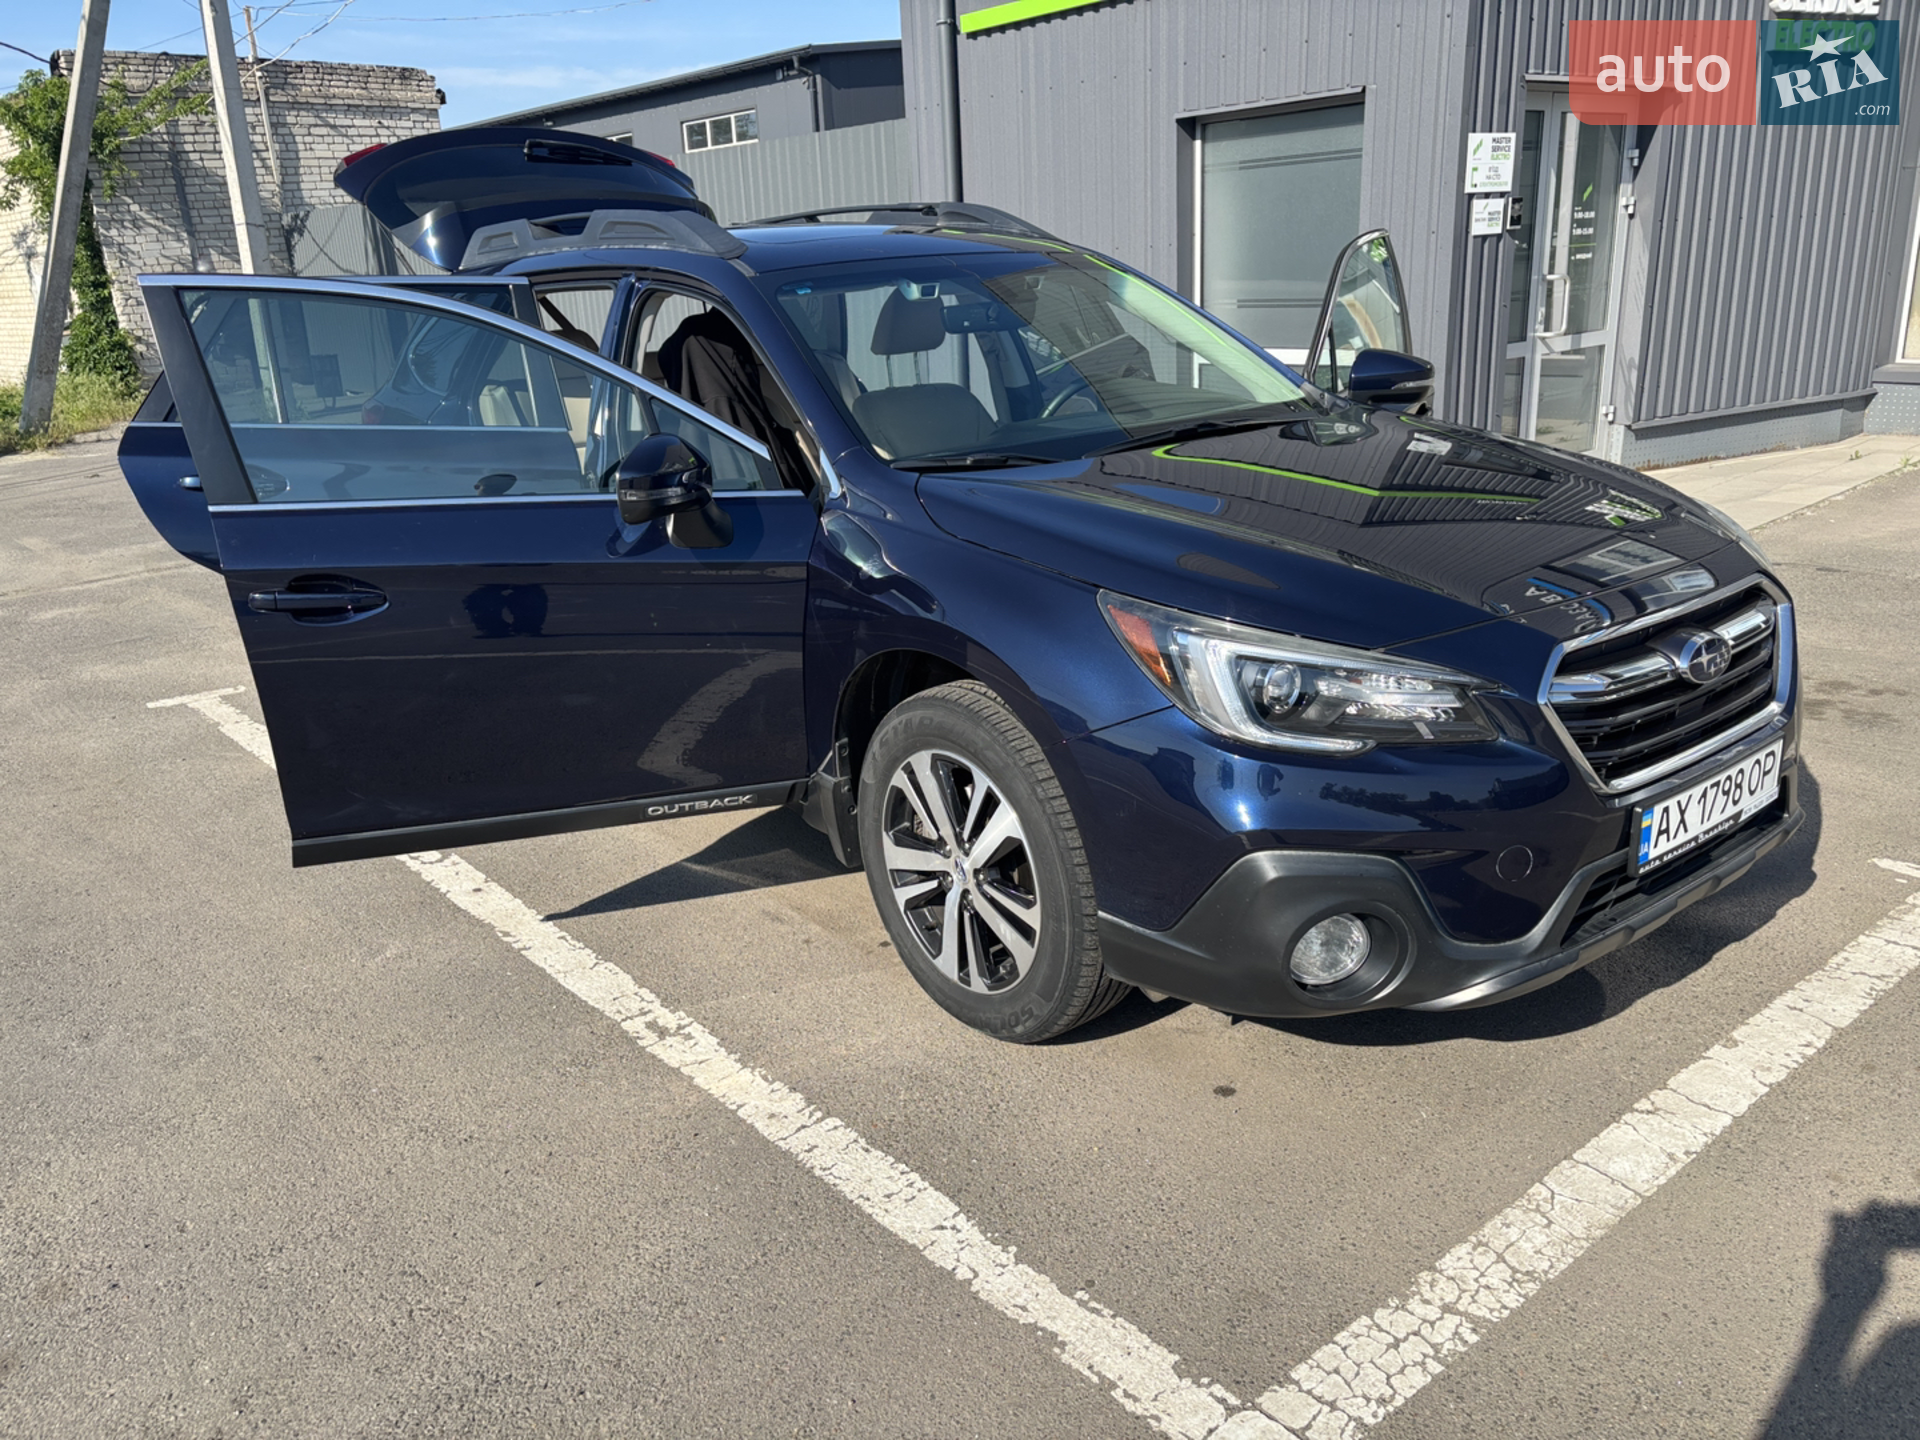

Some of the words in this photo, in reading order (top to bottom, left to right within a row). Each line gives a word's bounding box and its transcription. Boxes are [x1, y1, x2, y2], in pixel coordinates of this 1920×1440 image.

[1491, 145, 1511, 153] SERVICE
[648, 794, 753, 815] OUTBACK
[1653, 794, 1693, 849] AX
[1697, 768, 1745, 825] 1798
[1748, 750, 1776, 796] OP
